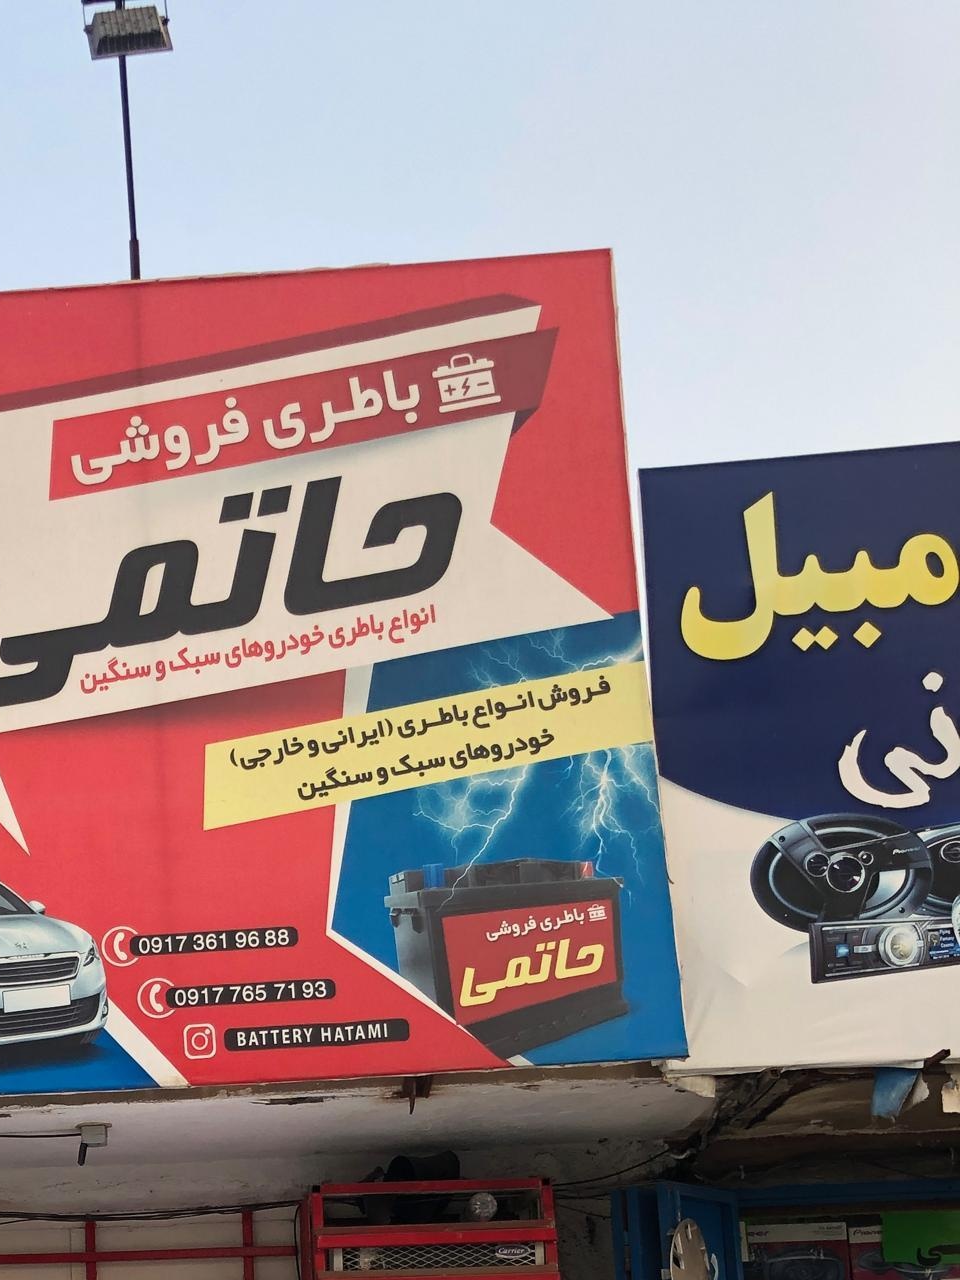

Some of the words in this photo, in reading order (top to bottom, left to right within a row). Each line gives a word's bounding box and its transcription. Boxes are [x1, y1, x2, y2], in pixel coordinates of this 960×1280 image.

[262, 369, 421, 450] باطری
[70, 396, 250, 485] فروشی
[327, 612, 384, 650] باطری
[387, 604, 437, 643] انواع
[170, 640, 221, 675] سبک
[224, 624, 325, 666] خودروهای
[80, 658, 152, 694] سنگین
[154, 660, 167, 683] و
[471, 690, 535, 728] انواع
[539, 674, 612, 711] فروش
[323, 717, 394, 757] (ایرانی
[396, 706, 469, 741] باطری
[307, 737, 319, 756] و
[448, 726, 556, 769] خودروهای
[377, 767, 389, 785] و
[392, 752, 446, 779] سبک
[296, 766, 373, 801] سنگین
[485, 915, 537, 942] فروشی
[539, 908, 585, 932] باطری
[138, 934, 186, 955] 0917
[192, 931, 228, 952] 361
[234, 930, 260, 949] 96
[264, 929, 290, 946] 88
[459, 937, 605, 1008] حاتمی
[173, 986, 222, 1007] 0917
[229, 984, 267, 1004] 765
[273, 982, 297, 1000] 71
[301, 980, 327, 998] 93
[236, 1026, 313, 1048] BATTERY
[320, 1022, 390, 1042] HATAMI
[497, 1246, 526, 1256] Carrier
